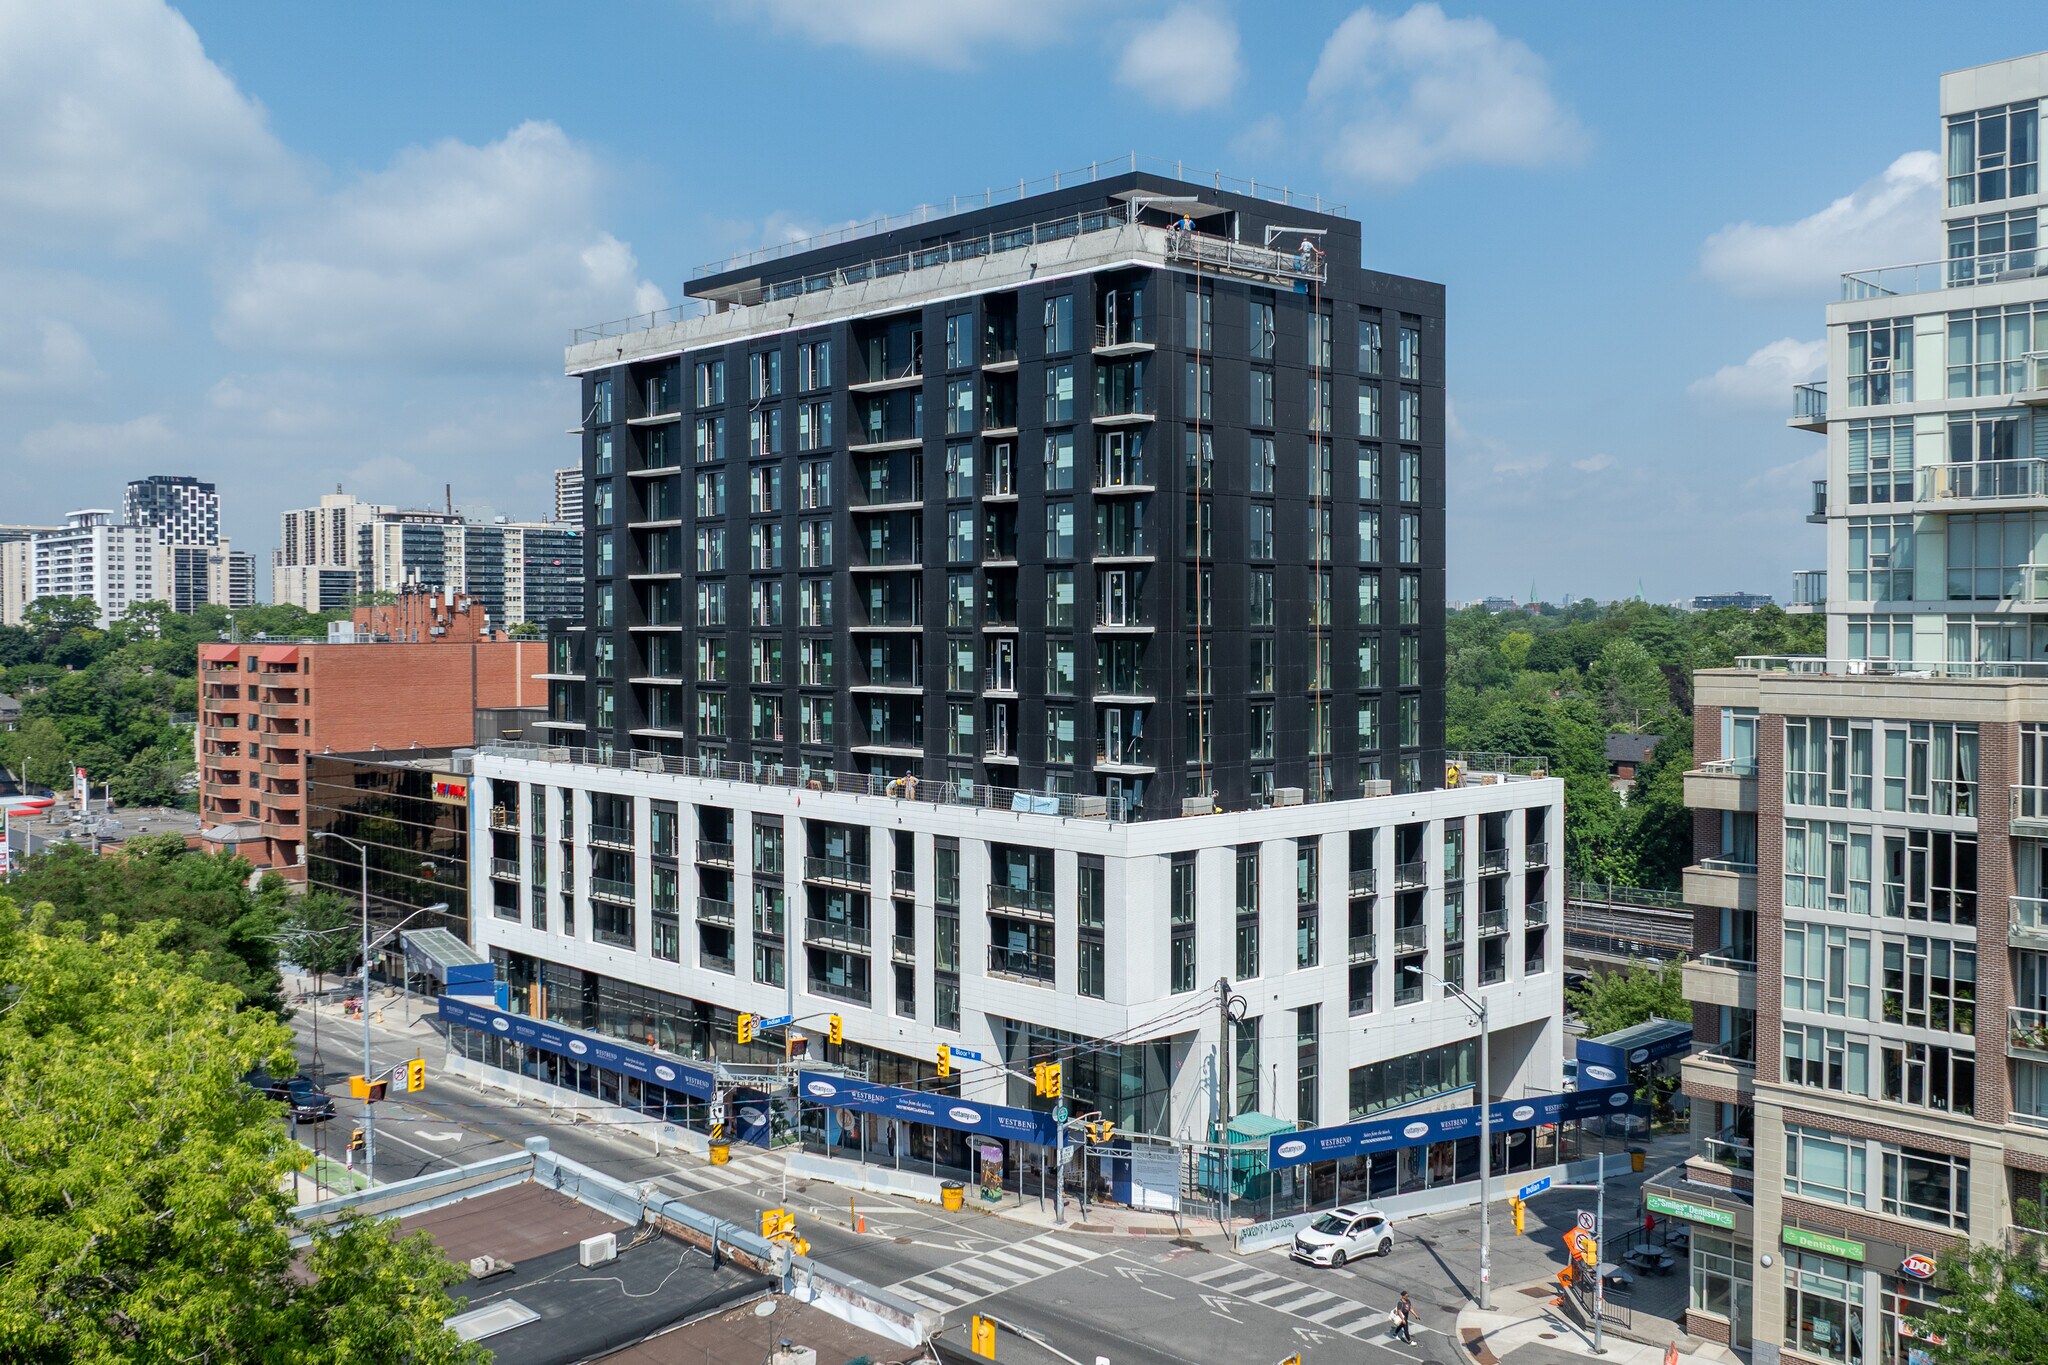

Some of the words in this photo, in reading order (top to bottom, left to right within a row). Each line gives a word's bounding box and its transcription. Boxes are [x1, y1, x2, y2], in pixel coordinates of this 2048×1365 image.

[766, 1018, 781, 1026] Indian
[955, 1049, 968, 1057] Bloor
[851, 1091, 885, 1102] WESTBEND
[997, 1117, 1038, 1129] WESTBEND
[1320, 1136, 1352, 1147] WESTBEND
[1525, 1183, 1540, 1195] Indian
[1689, 1205, 1721, 1221] Dentistry
[1799, 1236, 1846, 1255] Dentistry
[1909, 1258, 1930, 1275] DQ
